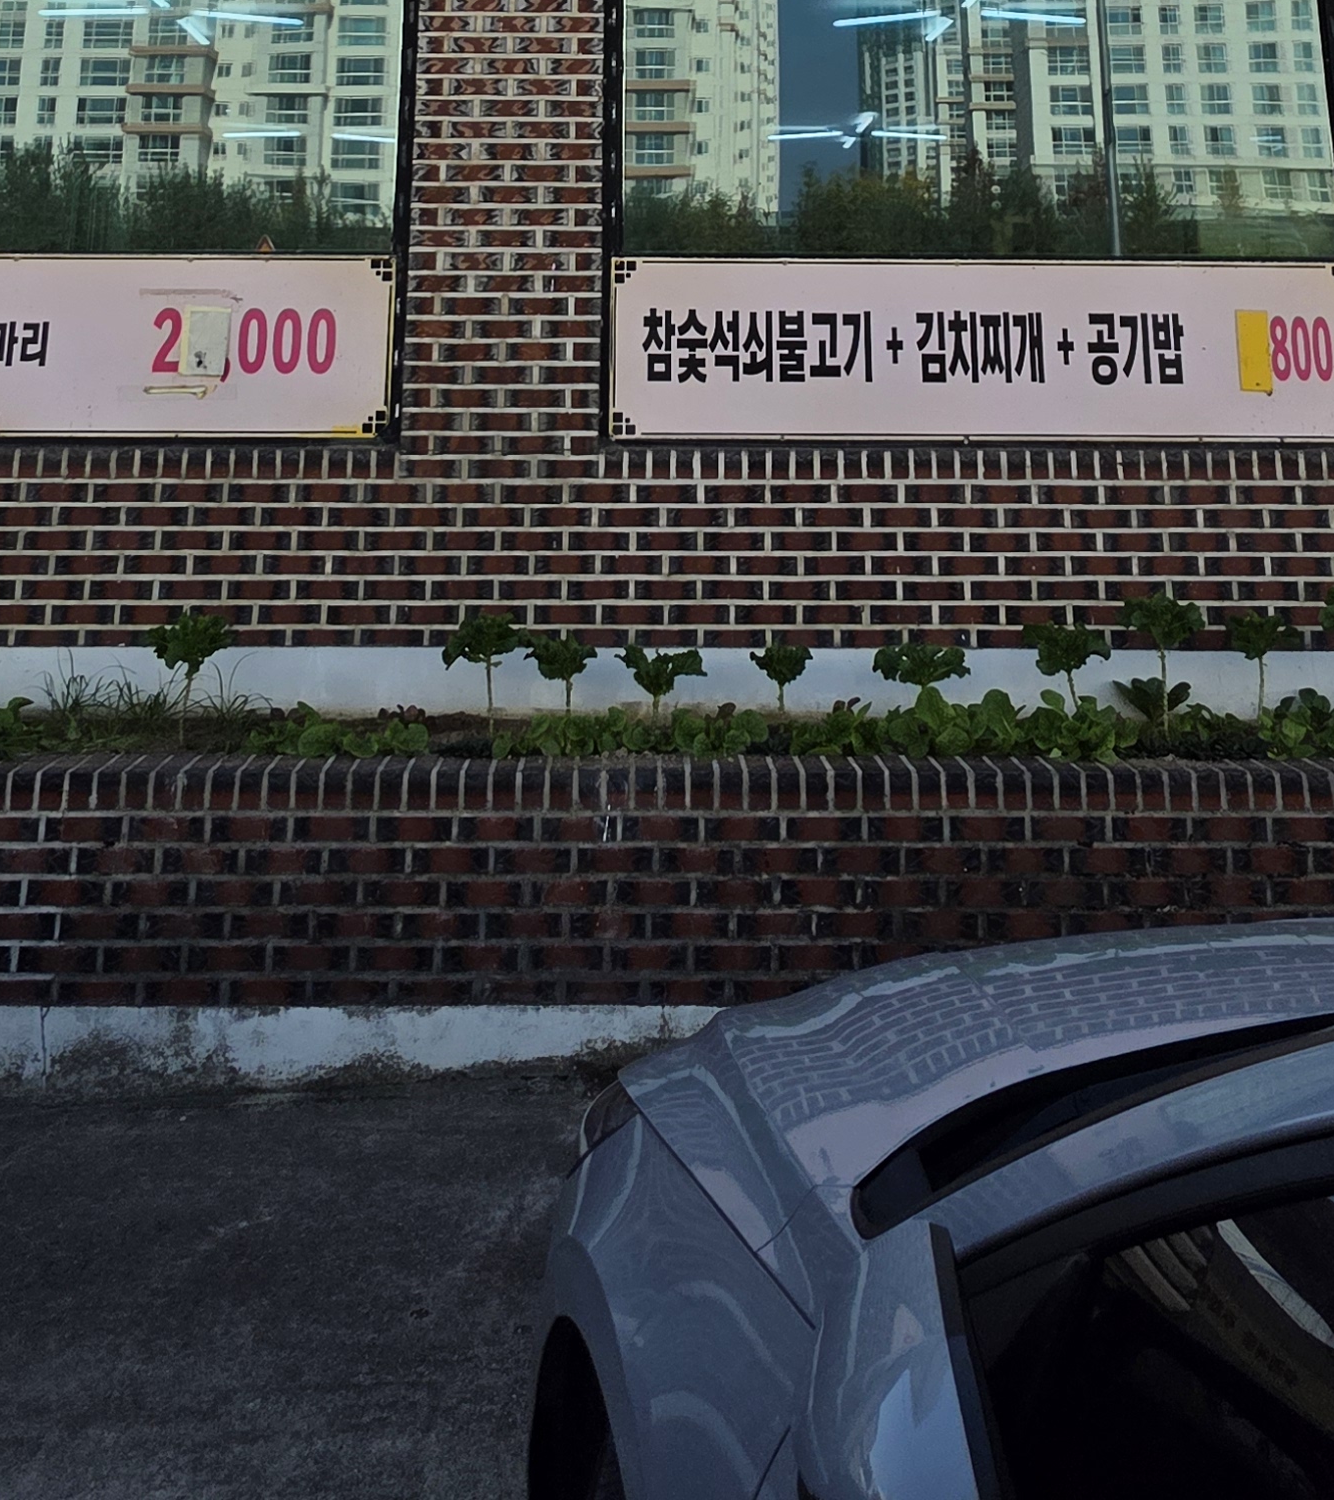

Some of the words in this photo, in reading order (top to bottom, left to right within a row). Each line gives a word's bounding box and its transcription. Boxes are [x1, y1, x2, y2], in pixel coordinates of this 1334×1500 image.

[151, 307, 337, 383] 2,000
[642, 308, 873, 384] 참숯석쇠불고기
[915, 311, 1046, 385] 김치찌개
[1087, 312, 1185, 386] 공기밥
